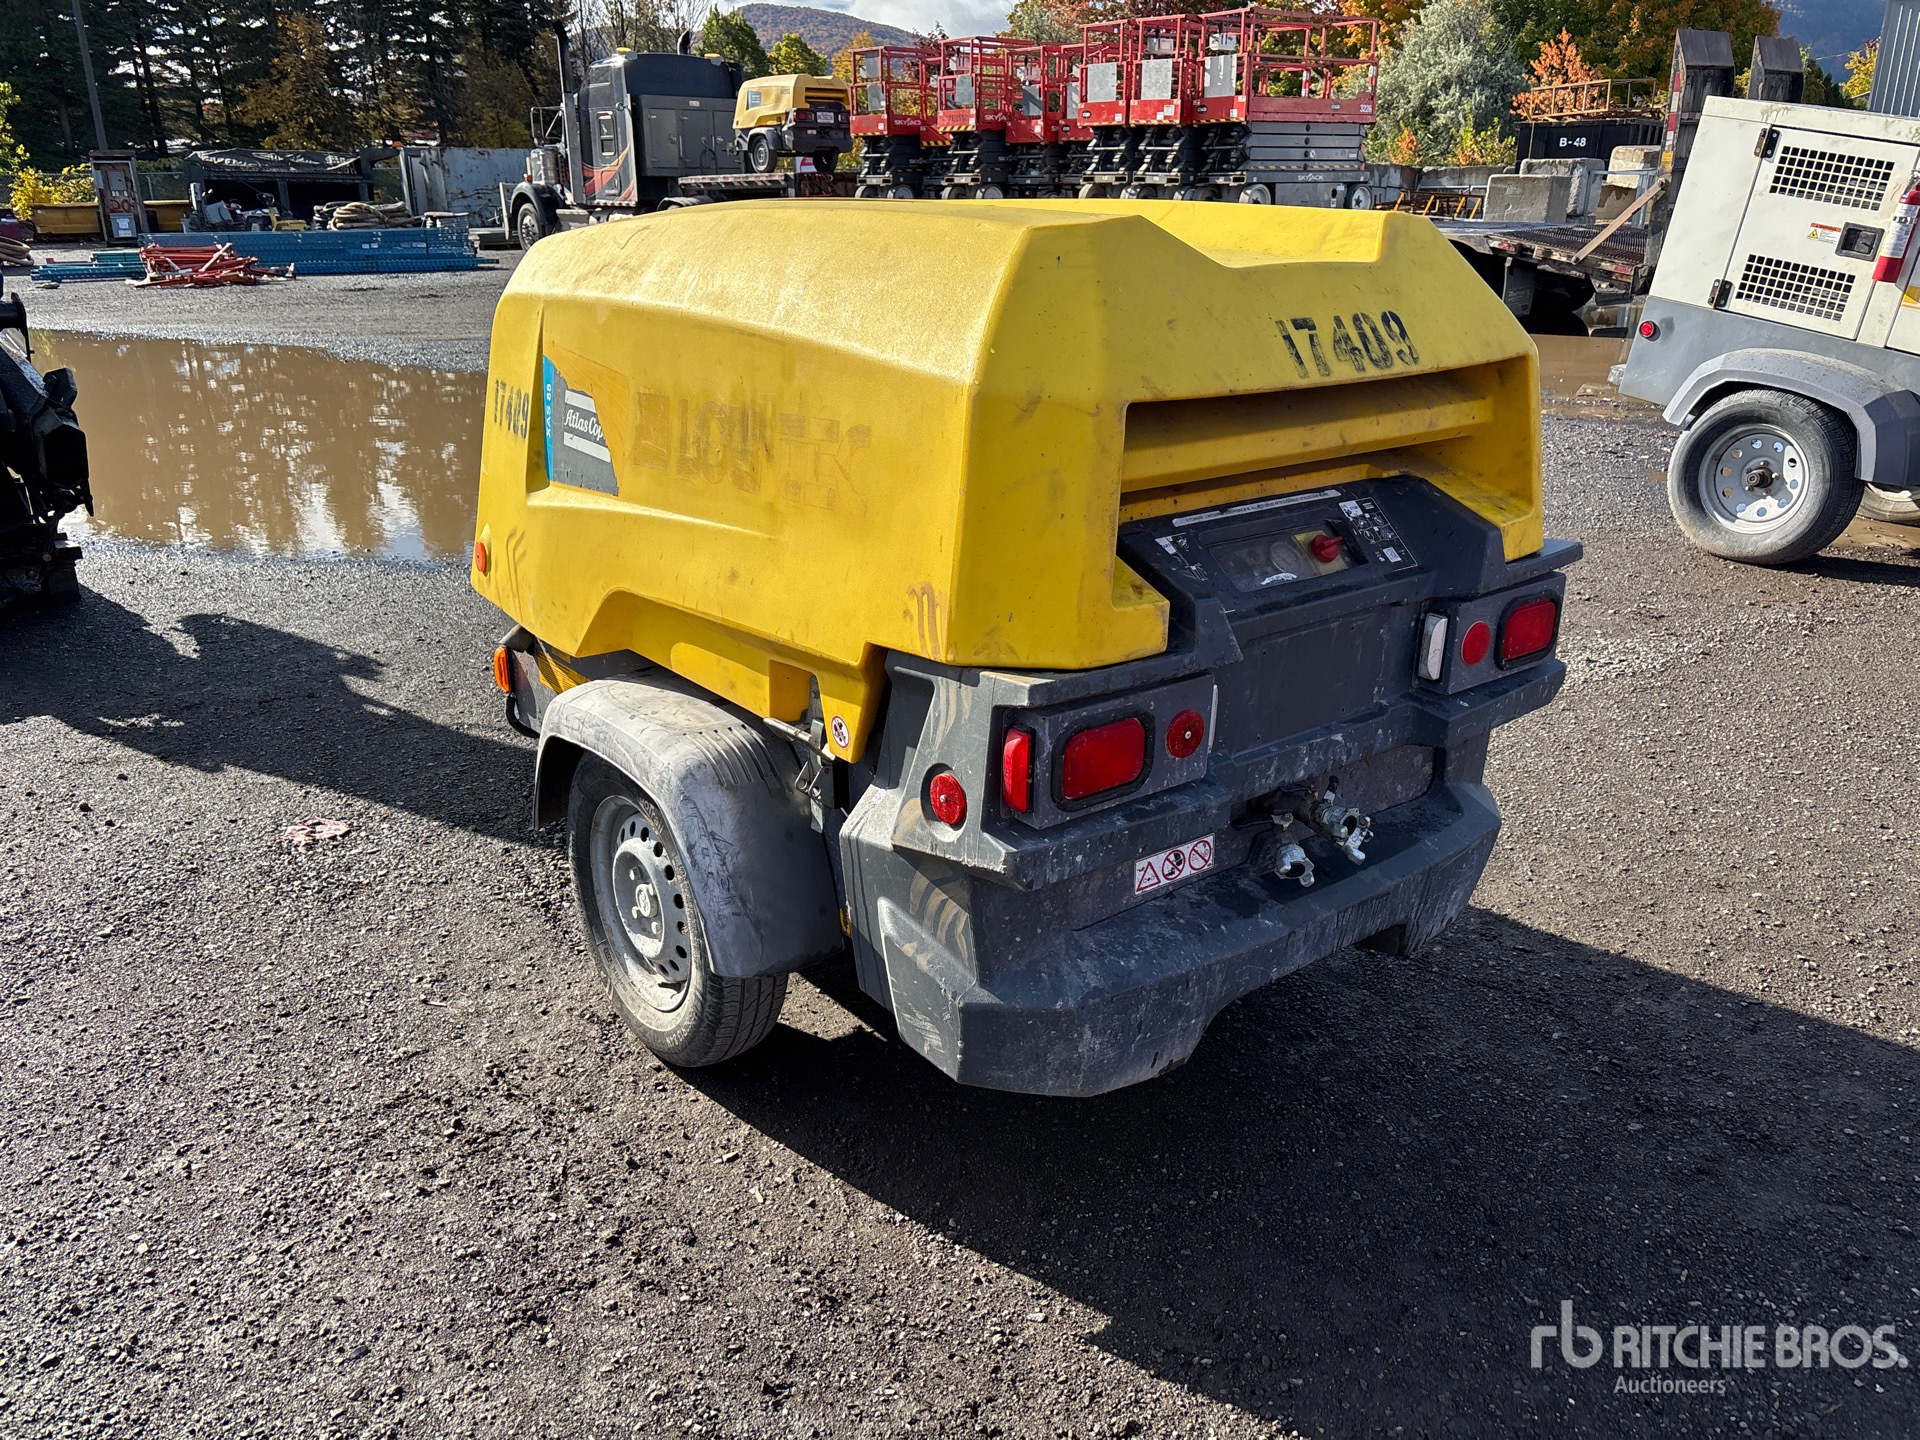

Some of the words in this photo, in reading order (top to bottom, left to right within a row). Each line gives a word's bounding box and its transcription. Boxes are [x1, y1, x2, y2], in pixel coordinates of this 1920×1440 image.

[894, 117, 922, 127] SKYJAC
[984, 112, 1007, 122] SKYJA
[1559, 137, 1587, 147] B-48
[1297, 172, 1324, 182] SKYJACK
[1275, 310, 1420, 379] 17409
[563, 409, 588, 433] Atlas
[588, 416, 606, 441] Cop
